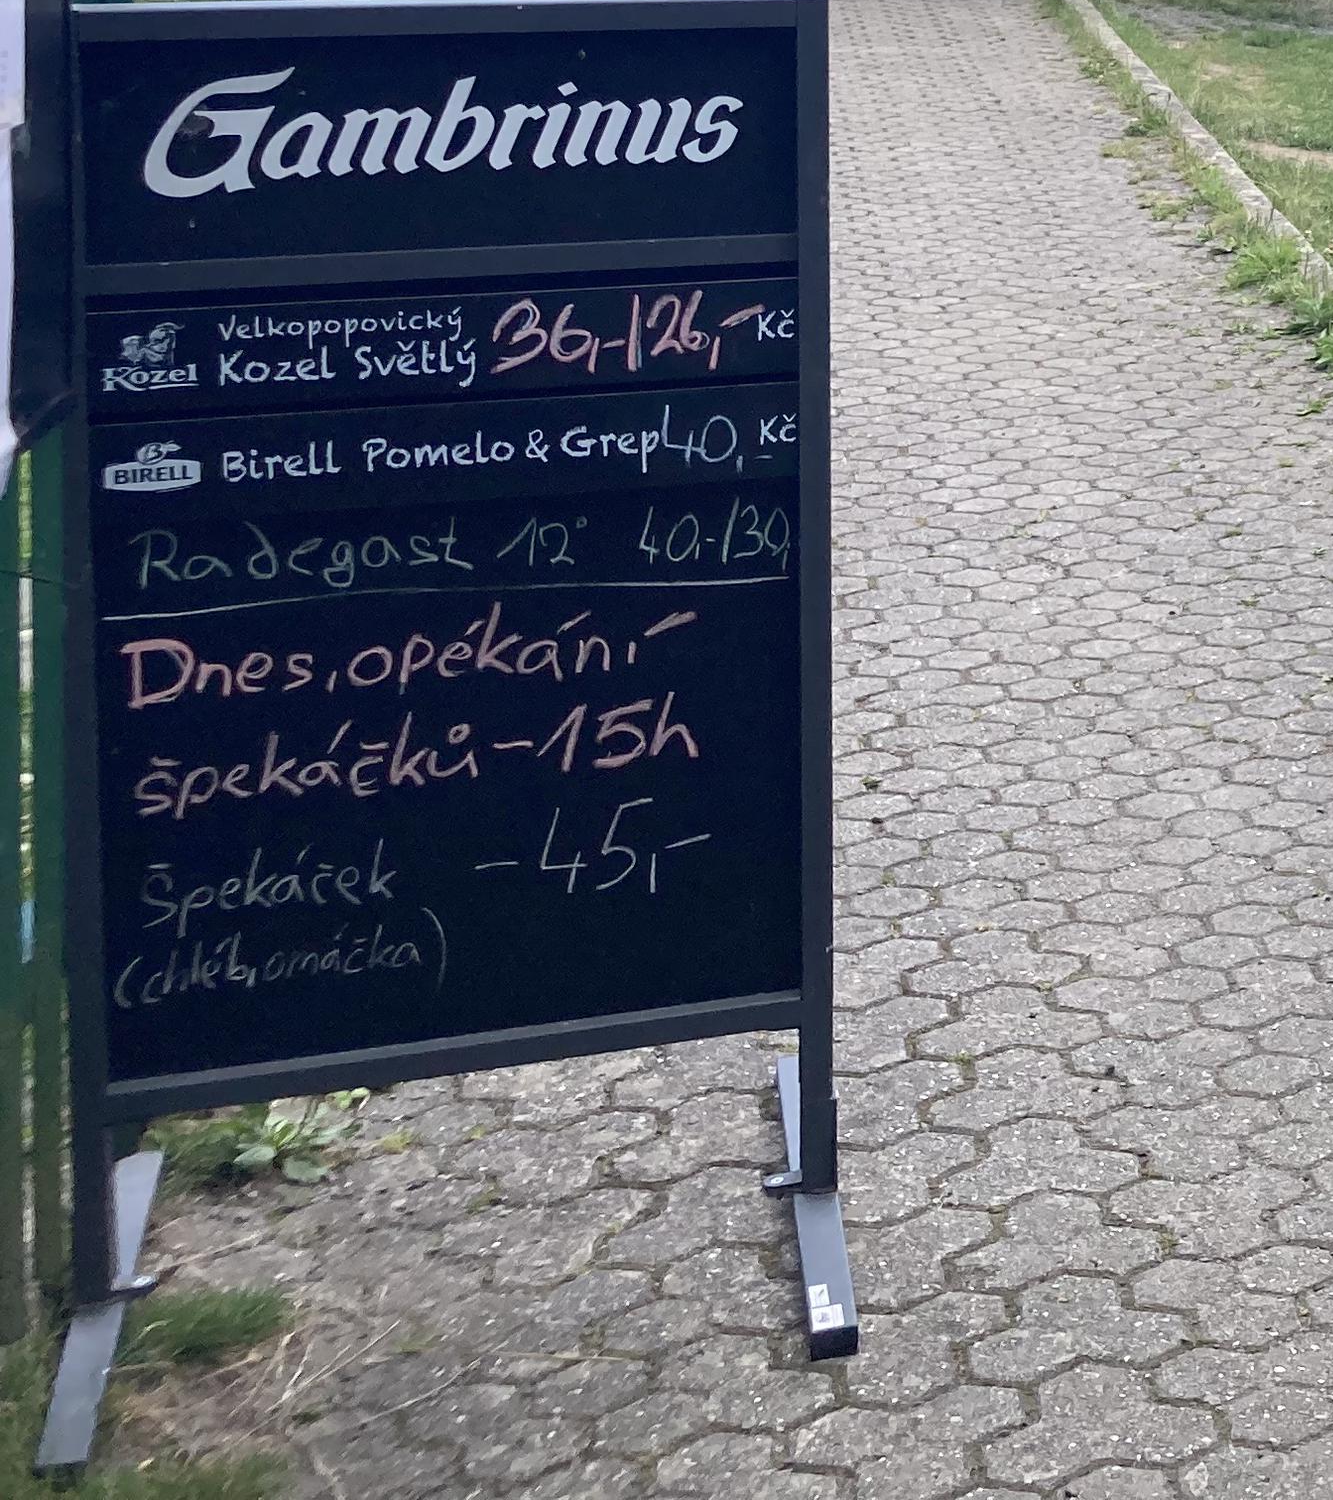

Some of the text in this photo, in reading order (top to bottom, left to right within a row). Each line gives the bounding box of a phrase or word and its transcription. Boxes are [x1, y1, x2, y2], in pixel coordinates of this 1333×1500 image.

[143, 66, 744, 199] Gambrinus
[218, 306, 463, 349] Velkopopovický
[218, 345, 336, 387] Kozel
[354, 338, 477, 388] Světlý
[757, 308, 796, 342] Kč
[102, 363, 200, 392] Kozel
[113, 465, 194, 486] BIRELL
[222, 439, 342, 483] Birell
[361, 429, 515, 473] Pomelo
[560, 425, 660, 474] Grep
[759, 412, 798, 446] Kč
[131, 520, 474, 590] Radegast
